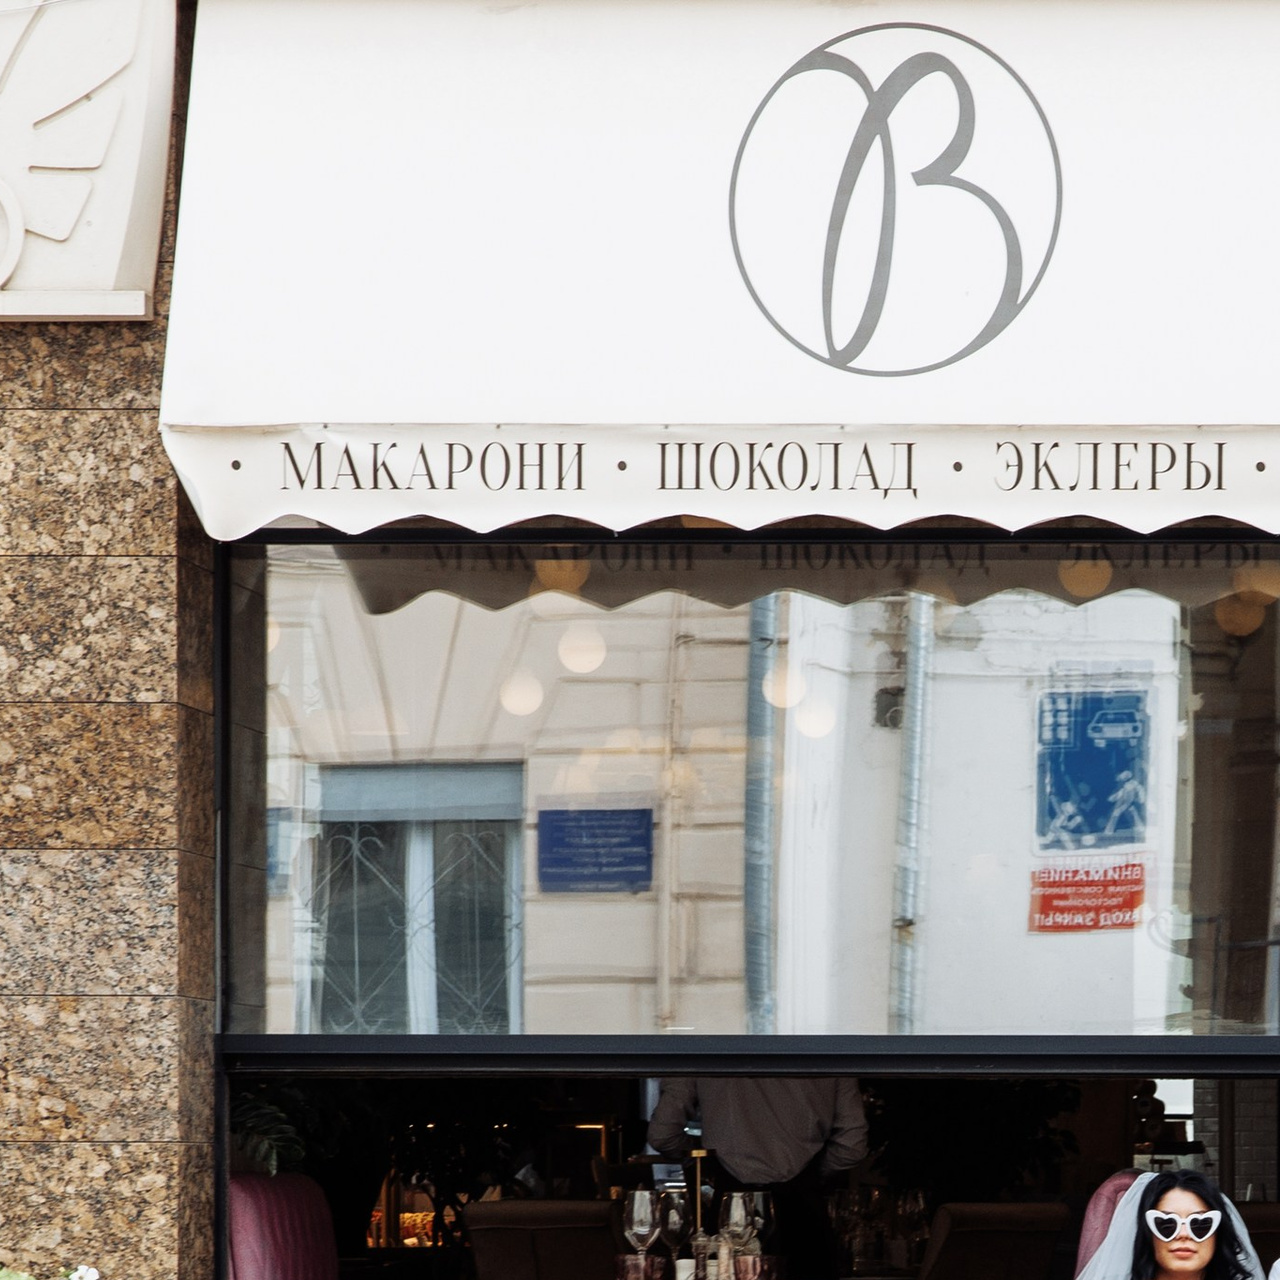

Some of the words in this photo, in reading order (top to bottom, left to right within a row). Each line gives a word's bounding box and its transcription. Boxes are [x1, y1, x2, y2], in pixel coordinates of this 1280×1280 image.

[280, 442, 586, 491] МАКАРОНИ
[656, 442, 918, 499] ШОКОЛАД
[995, 442, 1227, 492] ЭКЛЕРЫ
